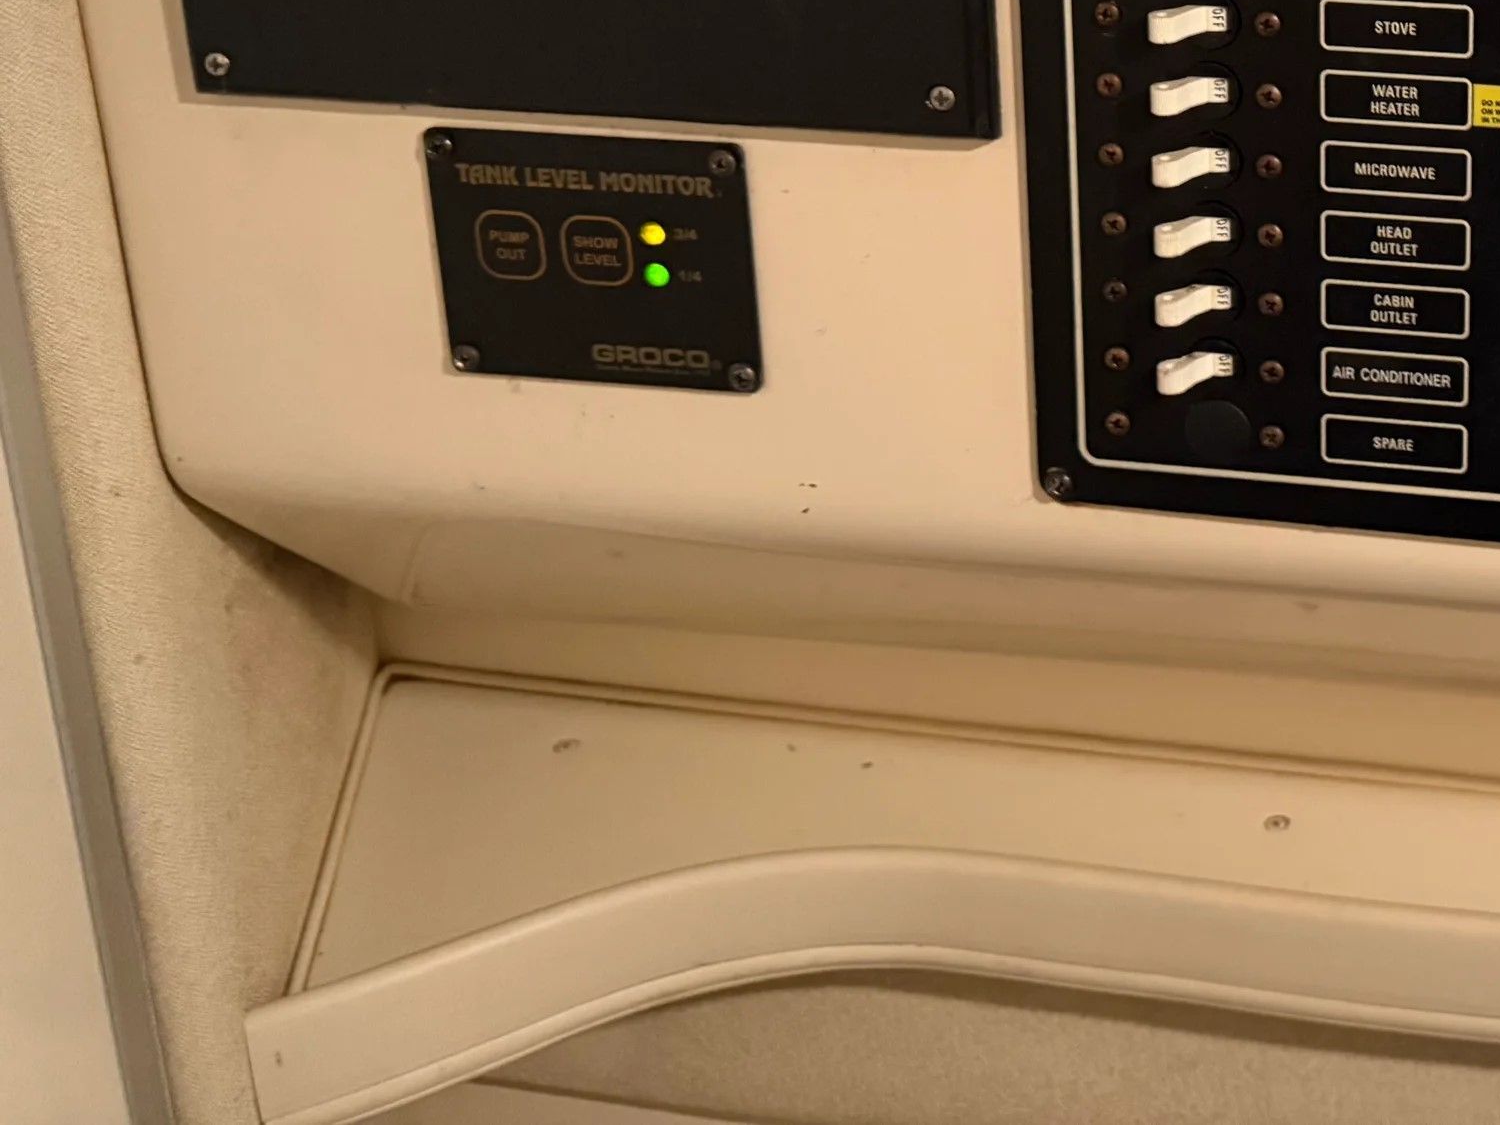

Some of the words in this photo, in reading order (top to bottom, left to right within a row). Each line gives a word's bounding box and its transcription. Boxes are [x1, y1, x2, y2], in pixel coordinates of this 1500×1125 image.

[1212, 8, 1225, 28] OFF
[1374, 20, 1417, 36] STOVE
[1214, 79, 1226, 99] OFF
[1372, 84, 1418, 100] WATER
[1370, 101, 1420, 117] HEATER
[1215, 150, 1227, 169] OFF
[1354, 162, 1436, 180] MICROWAVE
[455, 163, 518, 186] TANK
[526, 167, 594, 190] LEVEL
[601, 172, 714, 197] MONITOR
[1216, 218, 1228, 238] OFF
[1377, 225, 1412, 240] HEAD
[488, 230, 530, 244] PUMP
[573, 235, 618, 249] SHOW
[496, 248, 526, 260] OUT
[1370, 241, 1418, 257] OUTLET
[574, 253, 622, 267] LEVEL
[1374, 294, 1415, 309] CABIN
[1370, 310, 1418, 325] OUTLET
[592, 343, 710, 368] GROCO
[1332, 365, 1355, 380] AIR
[1360, 368, 1451, 388] CONDITIONER
[1372, 436, 1414, 452] SPARE
